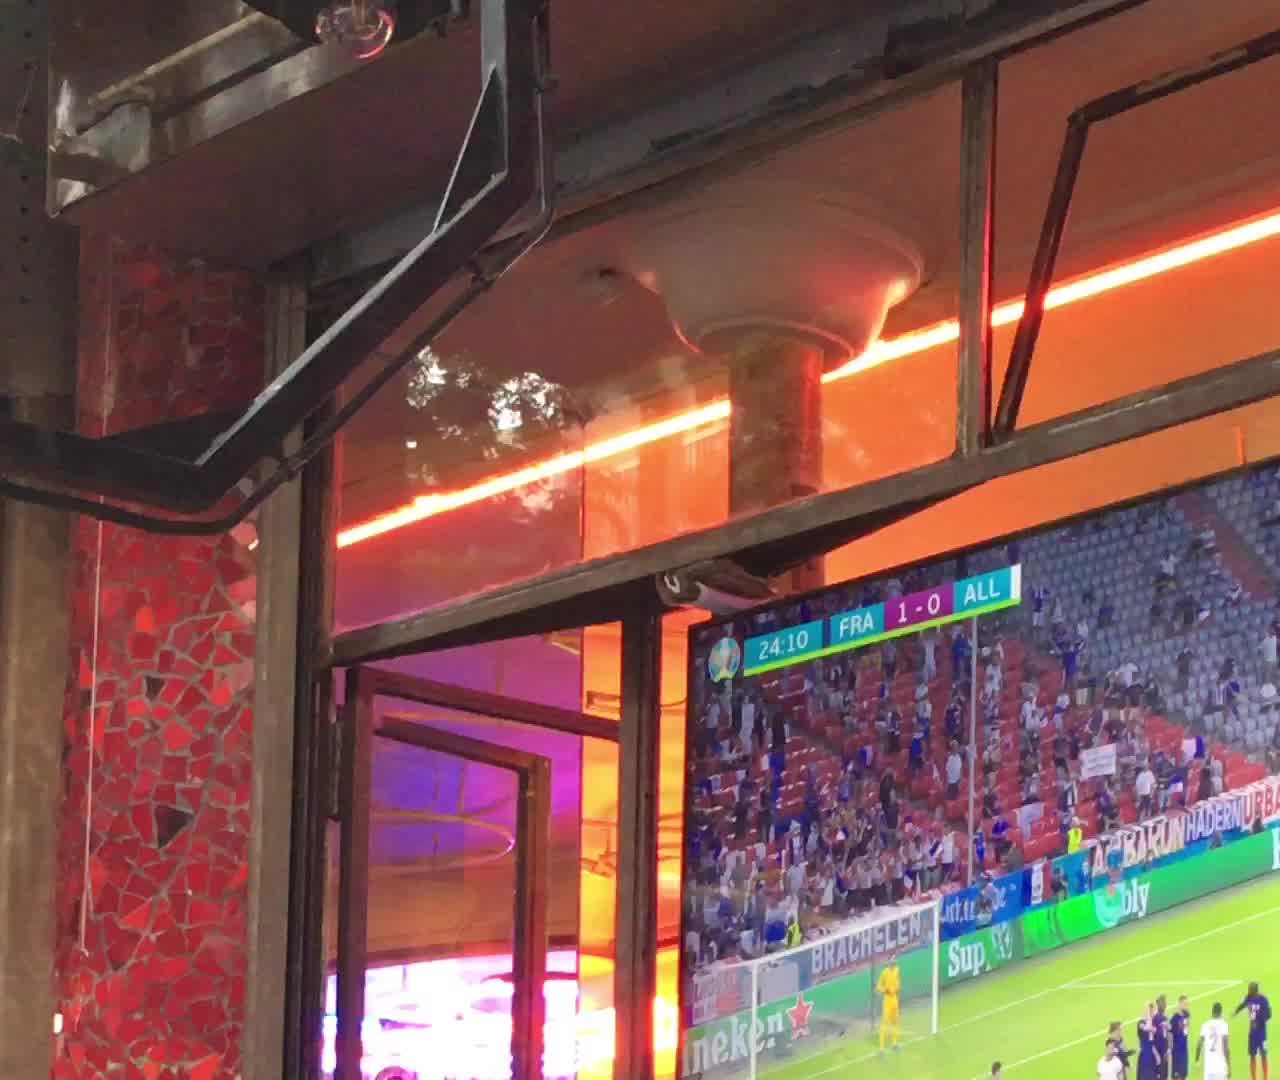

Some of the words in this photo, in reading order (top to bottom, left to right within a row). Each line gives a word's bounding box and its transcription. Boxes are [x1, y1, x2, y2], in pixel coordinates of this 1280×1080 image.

[758, 630, 809, 660] 24:10
[839, 612, 874, 637] FRA
[962, 578, 1001, 605] ALL
